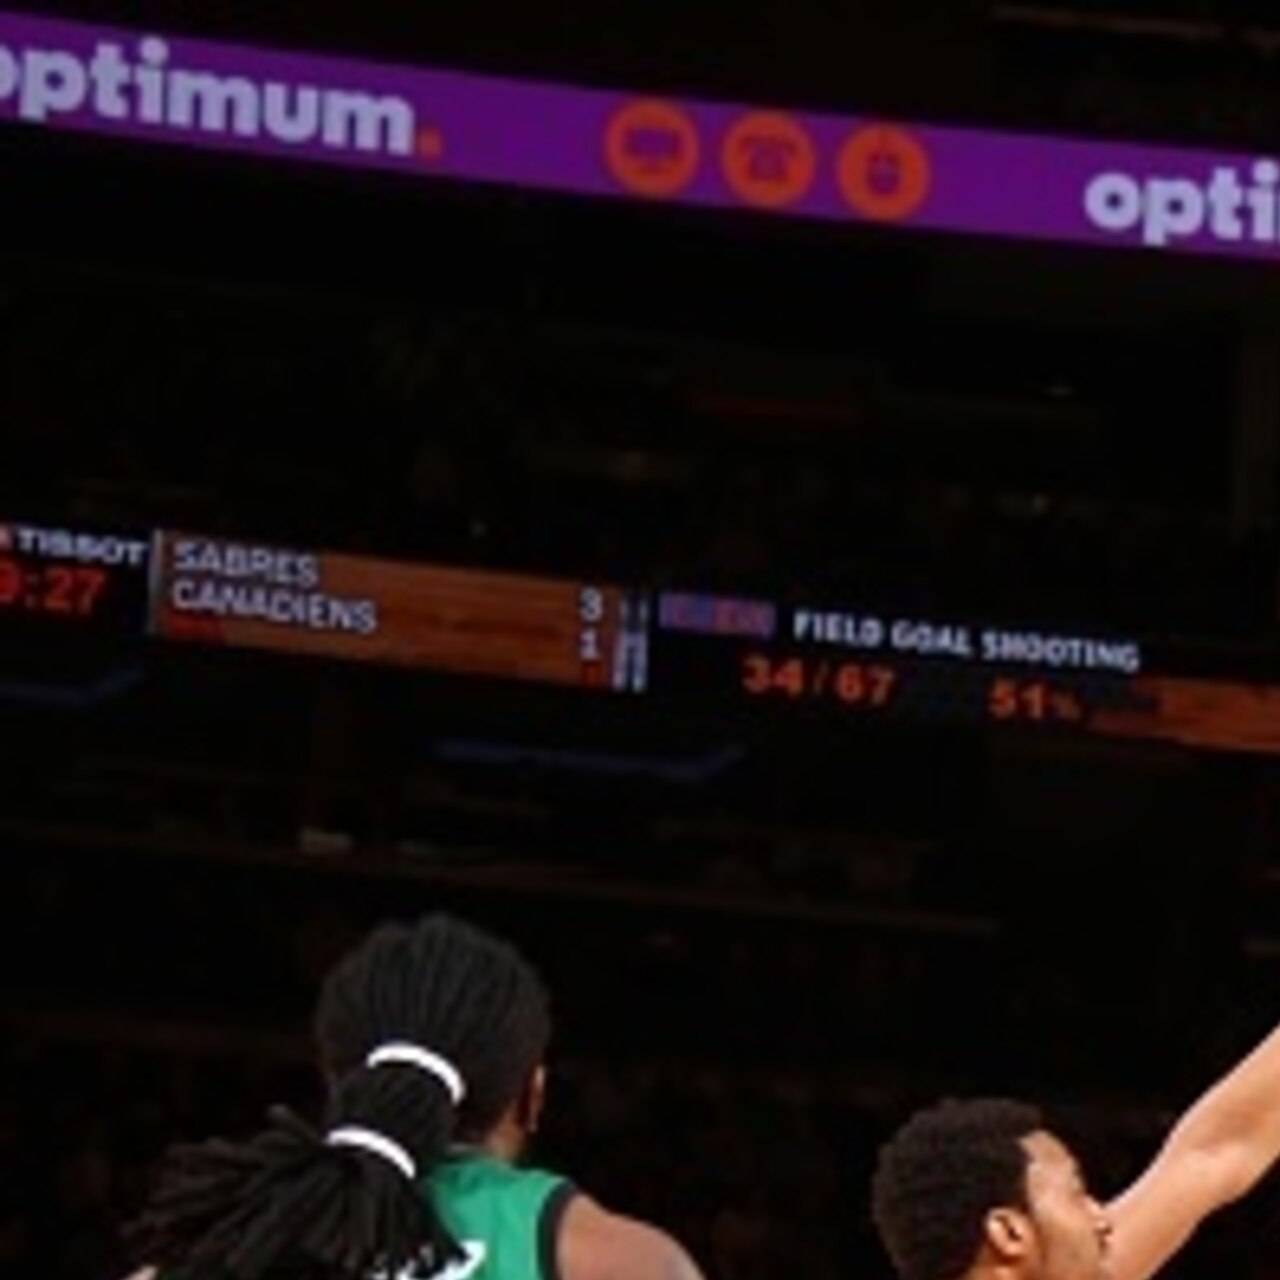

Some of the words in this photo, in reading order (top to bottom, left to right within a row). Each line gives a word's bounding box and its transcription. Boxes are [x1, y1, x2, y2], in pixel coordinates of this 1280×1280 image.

[172, 540, 318, 588] SABRES
[580, 588, 603, 622] 3
[172, 581, 377, 635] CANADIENS
[580, 632, 601, 660] 1
[794, 610, 884, 647] FIELD
[891, 620, 970, 656] GOAL
[982, 631, 1140, 673] SHOOTING
